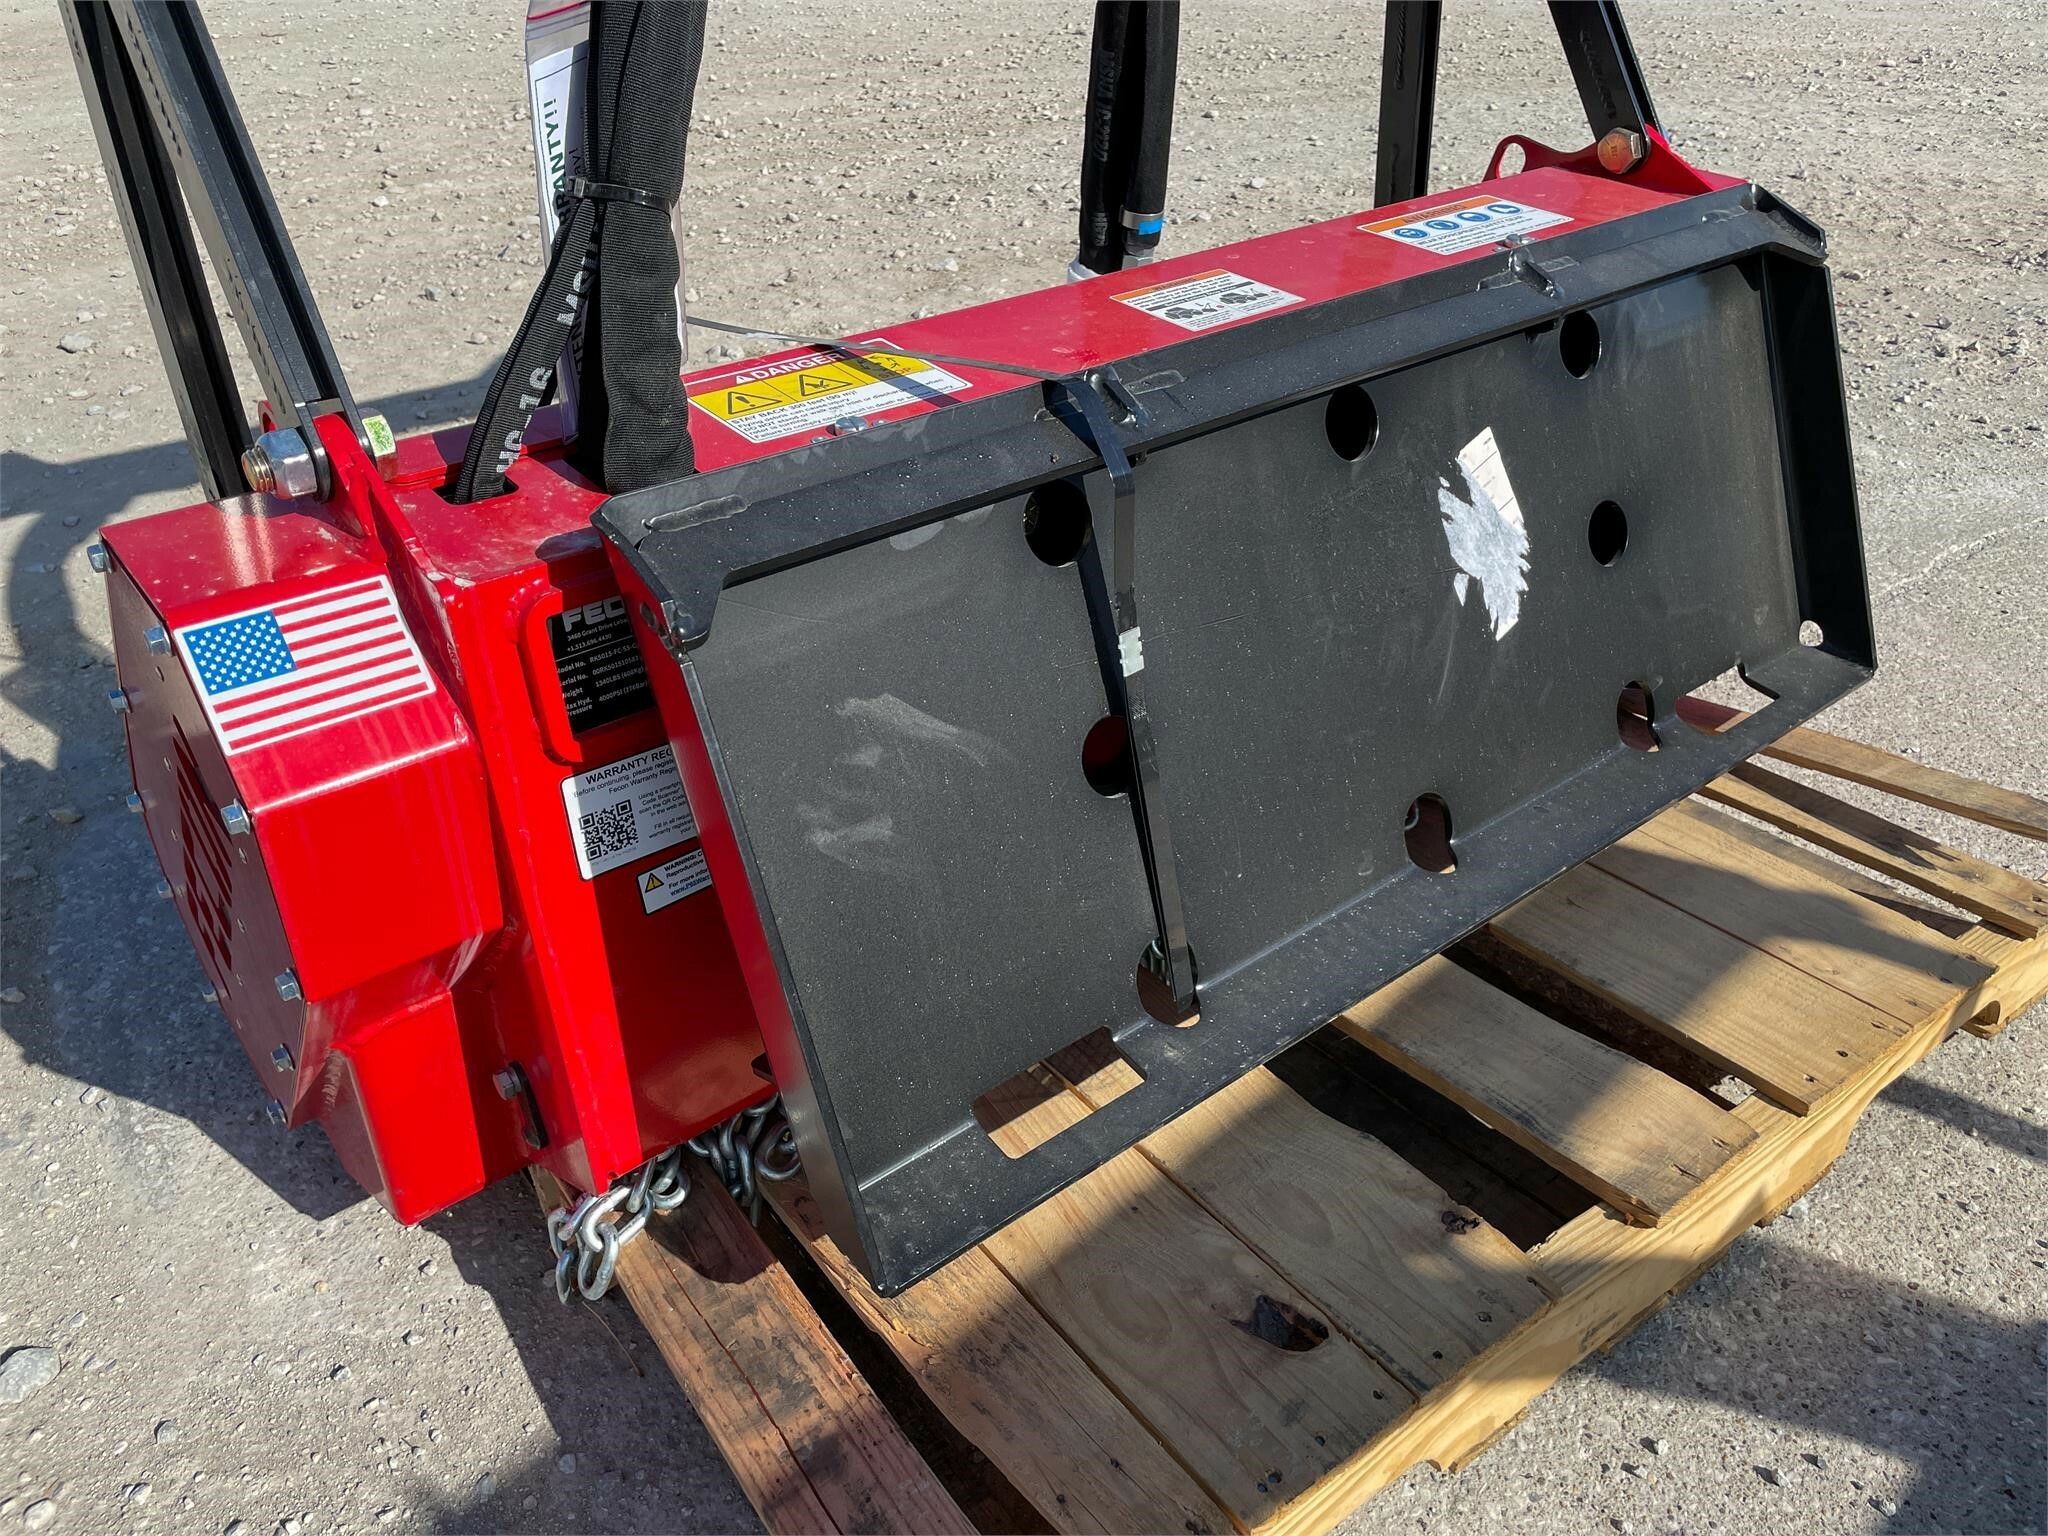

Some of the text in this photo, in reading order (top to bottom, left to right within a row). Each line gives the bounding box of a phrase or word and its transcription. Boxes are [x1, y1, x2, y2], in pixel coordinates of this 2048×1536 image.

[543, 98, 571, 227] RRANTY!!
[751, 352, 846, 379] DANGER
[731, 415, 757, 424] STAY
[759, 407, 787, 418] BACK
[806, 399, 826, 408] feet
[737, 420, 764, 430] Flying
[764, 413, 789, 424] debris
[790, 410, 805, 418] can
[805, 404, 826, 413] cause
[743, 425, 758, 433] DO
[759, 420, 777, 429] NOT
[777, 414, 800, 425] stand
[809, 406, 827, 416] walk
[827, 403, 845, 412] near
[748, 427, 769, 437] rotor
[754, 430, 782, 440] Failure
[792, 419, 822, 430] comply
[822, 413, 843, 423] could
[581, 627, 598, 637] Grant
[598, 622, 613, 631] Drive
[575, 660, 587, 668] No.
[577, 696, 593, 708] Hyd.
[585, 755, 648, 785] WARRANTY
[632, 766, 654, 778] please
[608, 784, 629, 794] Fecon
[629, 772, 658, 786] Warranty
[652, 802, 662, 810] the
[664, 854, 697, 872] WARNING:
[666, 858, 704, 879] Reproductive
[668, 881, 679, 889] For
[679, 874, 694, 884] more
